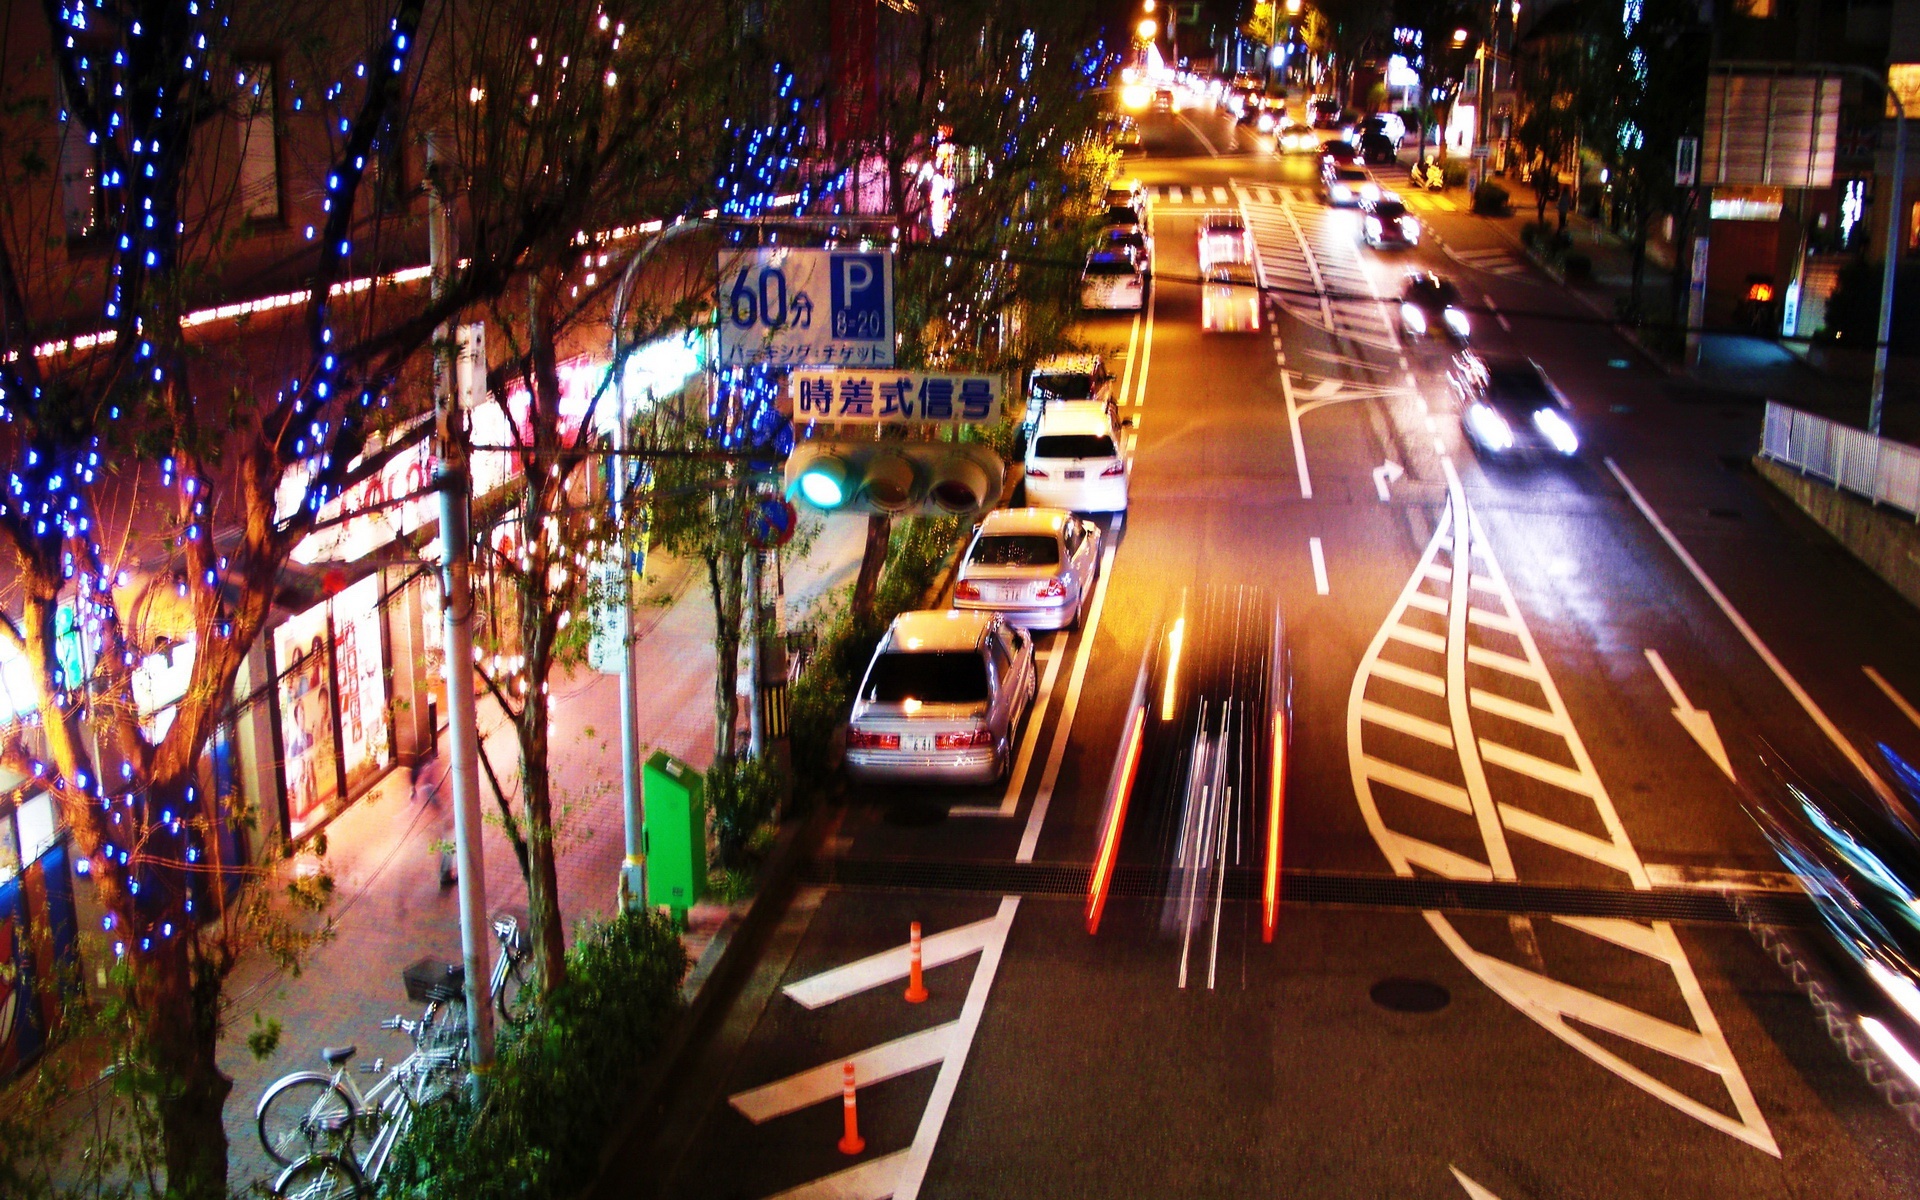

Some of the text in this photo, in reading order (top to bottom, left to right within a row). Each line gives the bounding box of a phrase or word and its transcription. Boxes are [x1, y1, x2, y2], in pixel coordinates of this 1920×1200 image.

[730, 265, 814, 330] 60分
[843, 258, 874, 310] P
[799, 375, 994, 420] 時差式信号
